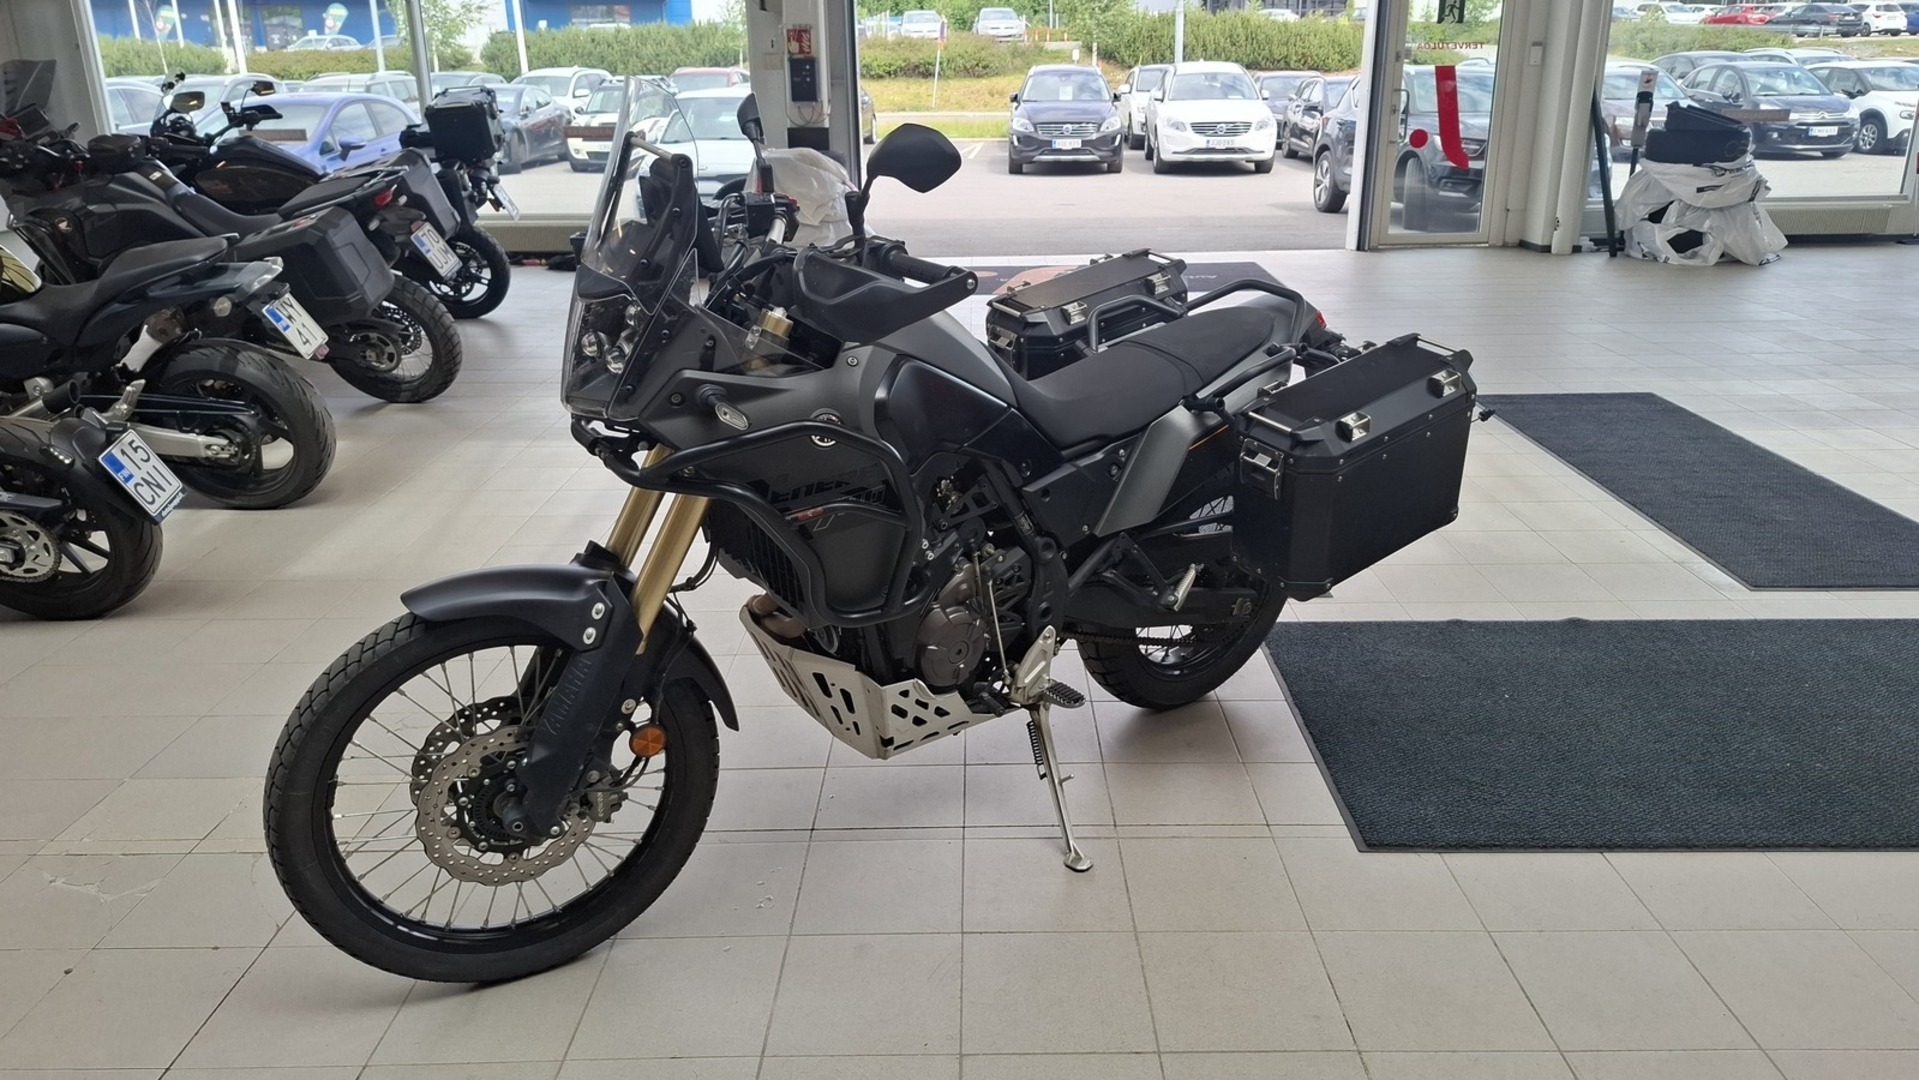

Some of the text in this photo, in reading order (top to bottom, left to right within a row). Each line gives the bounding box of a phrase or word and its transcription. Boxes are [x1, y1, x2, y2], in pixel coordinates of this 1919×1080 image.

[421, 229, 440, 248] 70
[275, 297, 302, 325] WY
[295, 322, 318, 346] 41
[120, 439, 151, 470] 15
[133, 465, 172, 505] CNI
